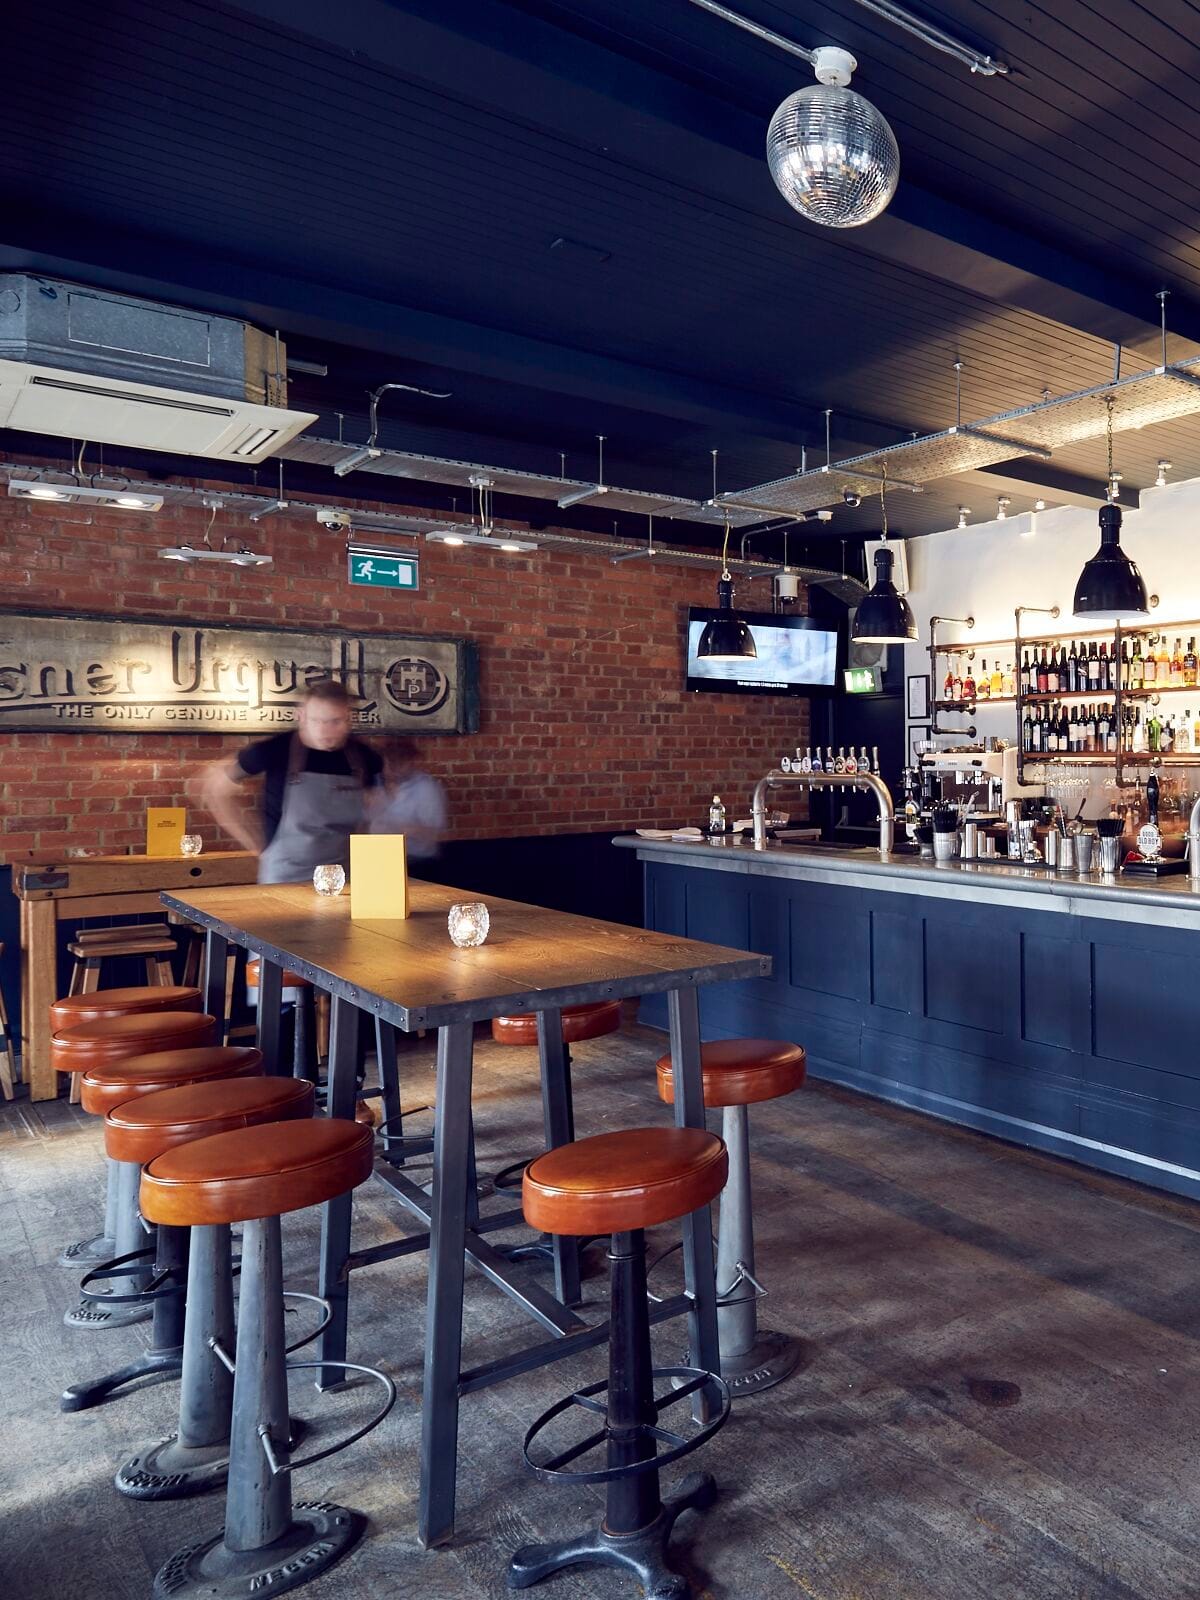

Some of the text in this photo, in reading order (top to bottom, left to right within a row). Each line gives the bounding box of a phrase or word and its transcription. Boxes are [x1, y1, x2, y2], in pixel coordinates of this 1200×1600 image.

[171, 630, 371, 710] Urquell
[52, 705, 94, 718] THE
[105, 706, 154, 719] ONLY
[164, 708, 247, 721] GENUINE
[351, 711, 381, 724] EER
